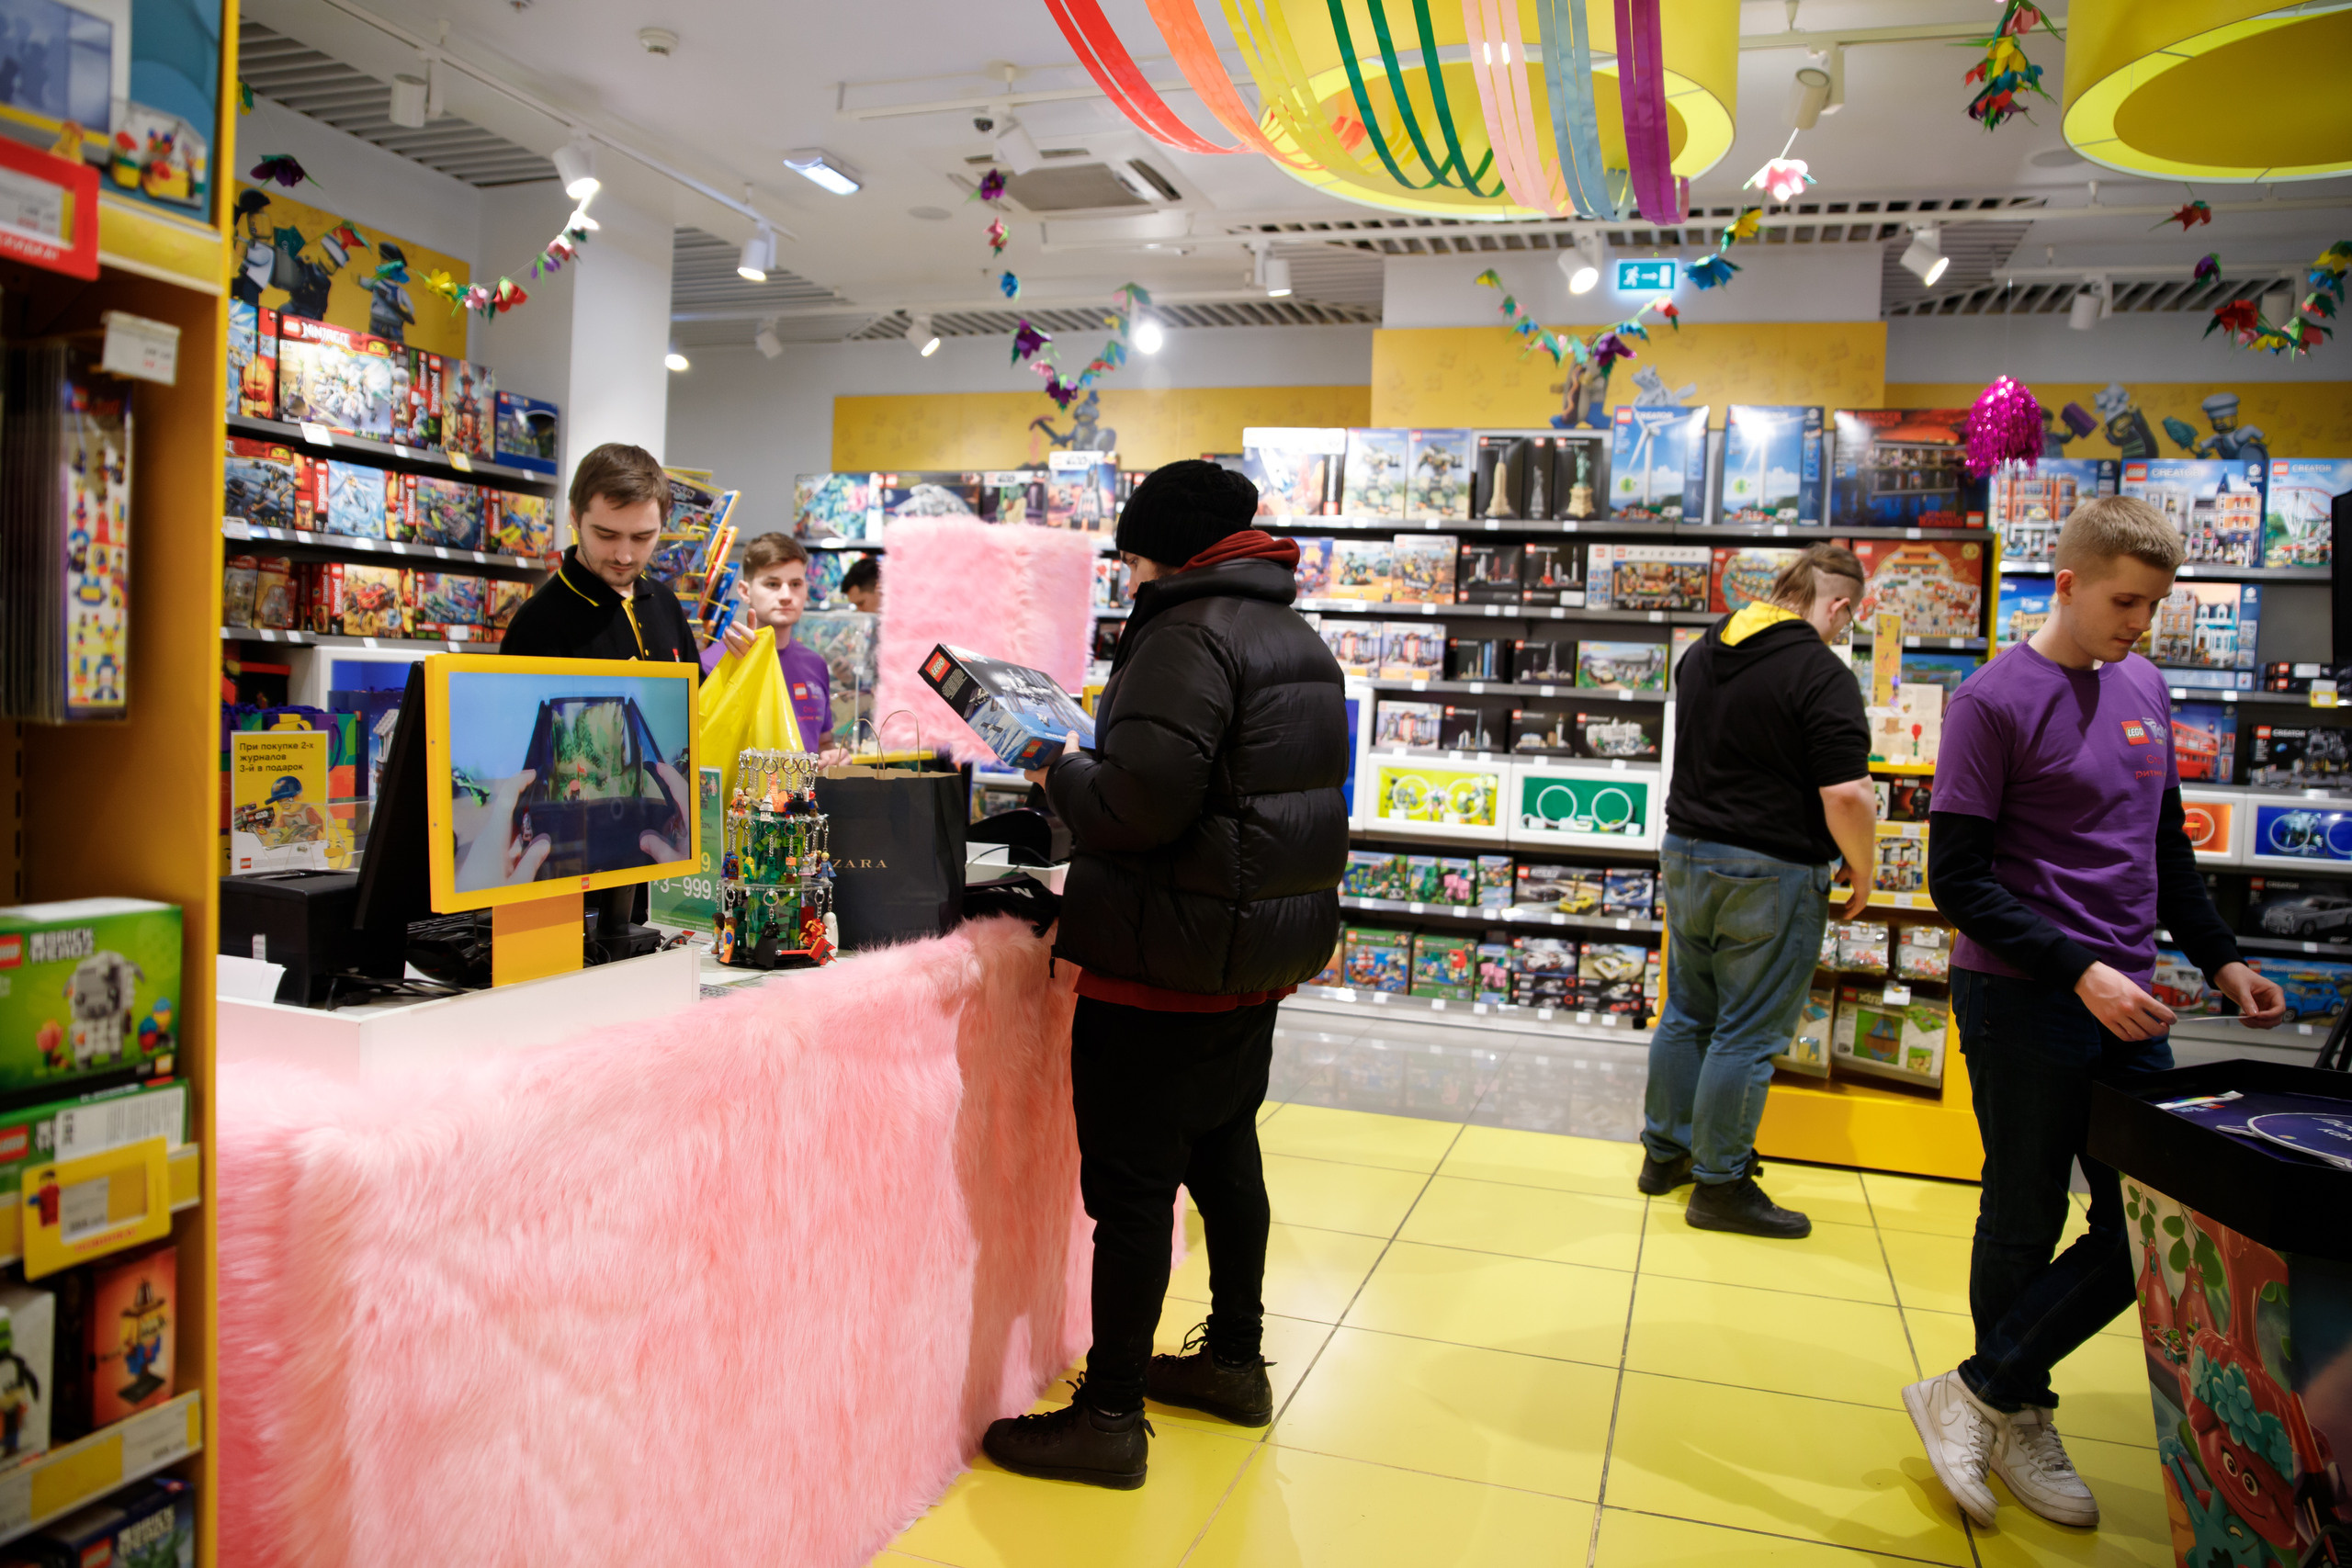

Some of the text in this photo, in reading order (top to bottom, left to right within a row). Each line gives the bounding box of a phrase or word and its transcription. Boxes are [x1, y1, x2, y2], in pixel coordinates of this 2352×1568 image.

[930, 656, 945, 677] LEGO
[2127, 727, 2144, 738] LEGO
[239, 741, 314, 752] При покупке 2-х
[239, 754, 287, 763] журналов
[239, 763, 254, 773] 3-й
[266, 764, 304, 774] подарок
[832, 859, 888, 869] ZARA
